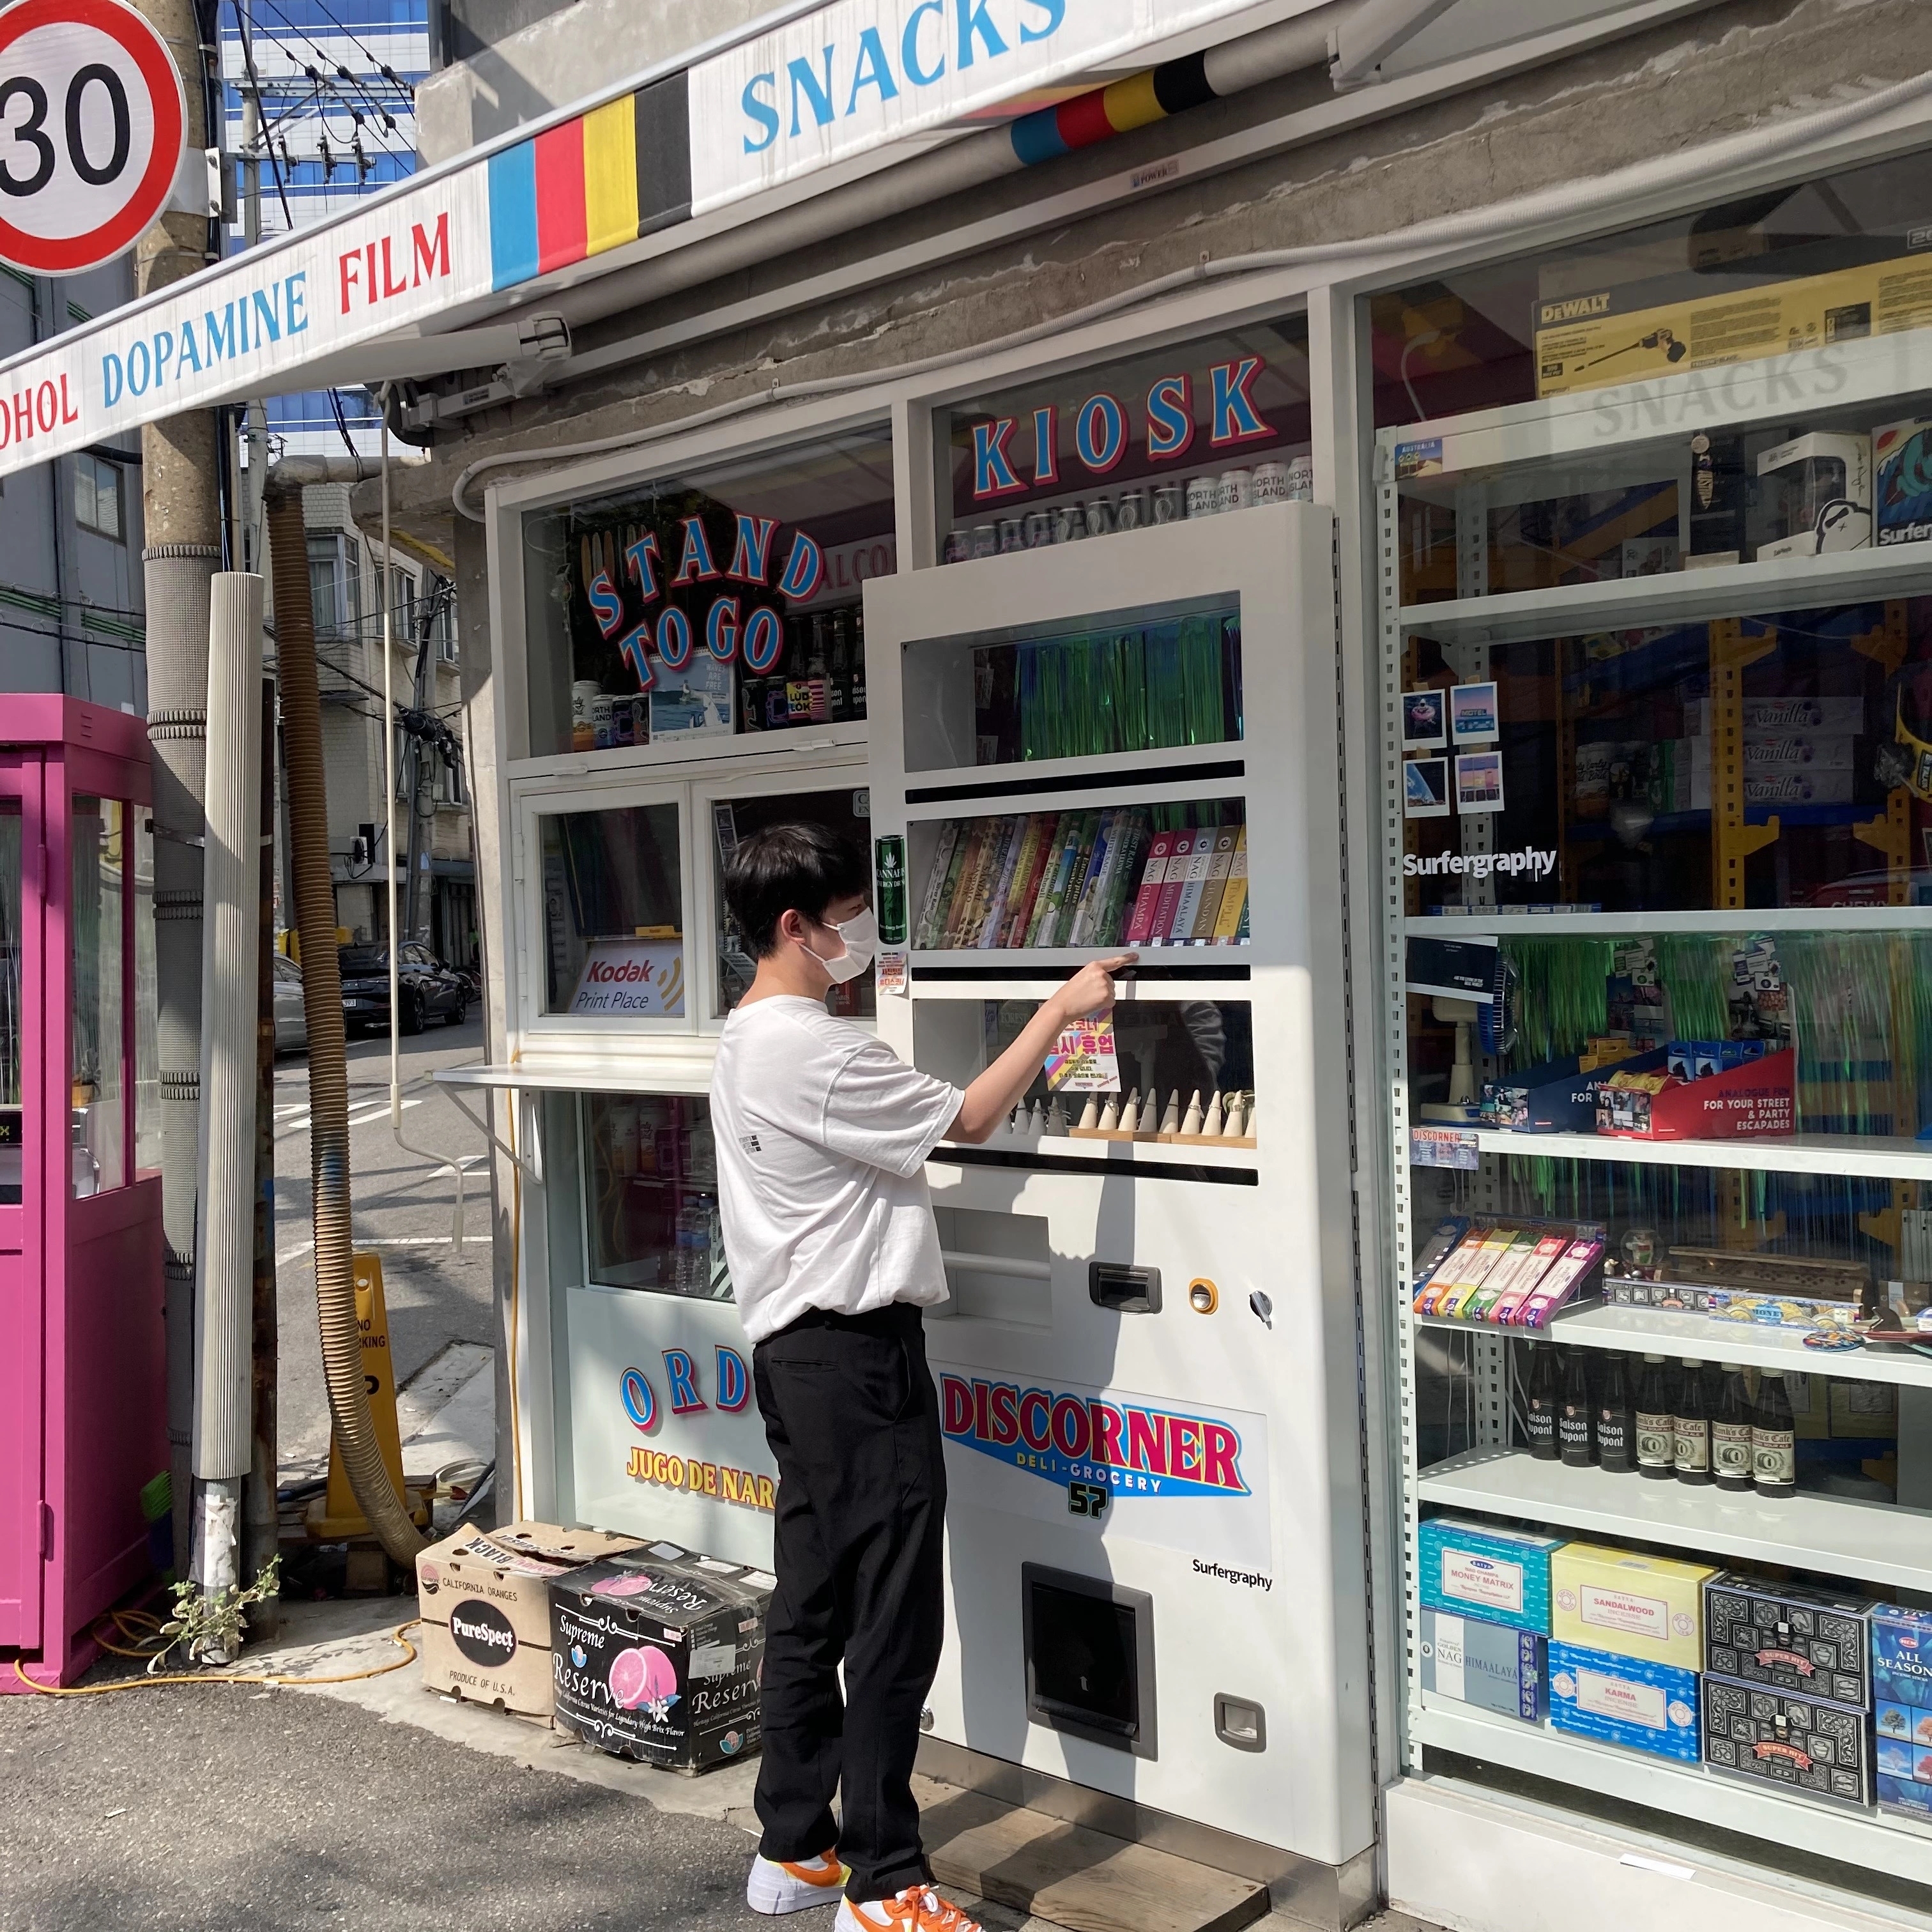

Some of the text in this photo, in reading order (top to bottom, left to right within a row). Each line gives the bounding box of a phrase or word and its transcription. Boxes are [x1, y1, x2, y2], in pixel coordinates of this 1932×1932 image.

[742, 0, 1066, 154] SNACKS
[0, 63, 130, 197] 30
[103, 272, 309, 408] DOPAMINE
[339, 212, 450, 315] FILM
[973, 353, 1277, 500] KIOSK
[1402, 441, 1435, 453] AUSTRALIA
[588, 513, 824, 638] STAND
[619, 595, 783, 691] TO GO
[705, 680, 722, 691] FREE
[707, 672, 722, 681] ARE
[1756, 703, 1809, 724] Vanilla
[1746, 740, 1800, 761] Vanilla
[1746, 776, 1800, 798] Vanilla
[1146, 859, 1160, 882] NAG
[1170, 857, 1183, 880] NAG
[1189, 855, 1202, 880] NAG
[1211, 854, 1224, 878] NAG
[1234, 852, 1246, 877] NAG
[1403, 847, 1556, 878] Surfergraphy
[933, 881, 942, 897] Silver
[974, 865, 990, 901] SANDAL
[1038, 862, 1054, 899] Patchouli
[1072, 857, 1090, 903] Eucalyptus
[1134, 885, 1152, 930] CHAMPA
[1155, 884, 1176, 935] MEDITATION
[1176, 882, 1195, 933] HIMAALAYA
[1199, 880, 1216, 931] CHANDAN
[586, 958, 656, 984] Kodak
[575, 991, 649, 1009] Print Place
[1080, 1034, 1115, 1055] 휴업
[1571, 1092, 1593, 1103] FOR
[1703, 1098, 1790, 1110] FOR YOUR STREET
[1736, 1119, 1790, 1131] ESCAPADES
[1747, 1109, 1790, 1119] & PARTY
[1413, 1130, 1462, 1143] DISCORNER
[1752, 1307, 1784, 1319] MONEY
[356, 1319, 371, 1331] NO
[619, 1344, 750, 1432] ORD
[940, 1374, 1251, 1495] DISCORNER
[1559, 1417, 1588, 1430] Saison
[1559, 1429, 1588, 1443] Dupont
[626, 1446, 776, 1510] JUGO DE NAR
[1068, 1482, 1108, 1519] 57
[465, 1537, 514, 1565] BLACK
[1192, 1559, 1273, 1591] Surfergraphy
[1471, 1560, 1494, 1570] Satya
[442, 1577, 518, 1602] CALIFORNIA ORANGES
[1451, 1569, 1514, 1590] MONEY MATRIX
[1593, 1597, 1655, 1616] SANDALWOOD
[1607, 1608, 1642, 1620] INCENSE
[452, 1616, 514, 1648] PureSpect
[560, 1614, 606, 1650] Supreme
[1437, 1642, 1462, 1653] GOLDEN
[1437, 1647, 1462, 1664] NAG
[1764, 1651, 1805, 1666] SUPER HIT
[1895, 1650, 1922, 1664] ALL
[703, 1660, 751, 1689] Supeme
[1465, 1655, 1518, 1680] HIMAALAYA
[1877, 1657, 1932, 1676] SEASON
[449, 1670, 516, 1696] PRODUCE OF U.S.A.
[553, 1652, 625, 1710] Reserve
[1604, 1687, 1637, 1701] KARMA
[578, 1698, 590, 1710] Citrus
[590, 1702, 608, 1717] Varieties
[615, 1713, 638, 1729] Legendary
[638, 1719, 652, 1733] High
[652, 1724, 665, 1734] Brix
[665, 1726, 686, 1737] Flavor
[710, 1710, 730, 1723] California
[1762, 1744, 1804, 1759] SUPER HIT
